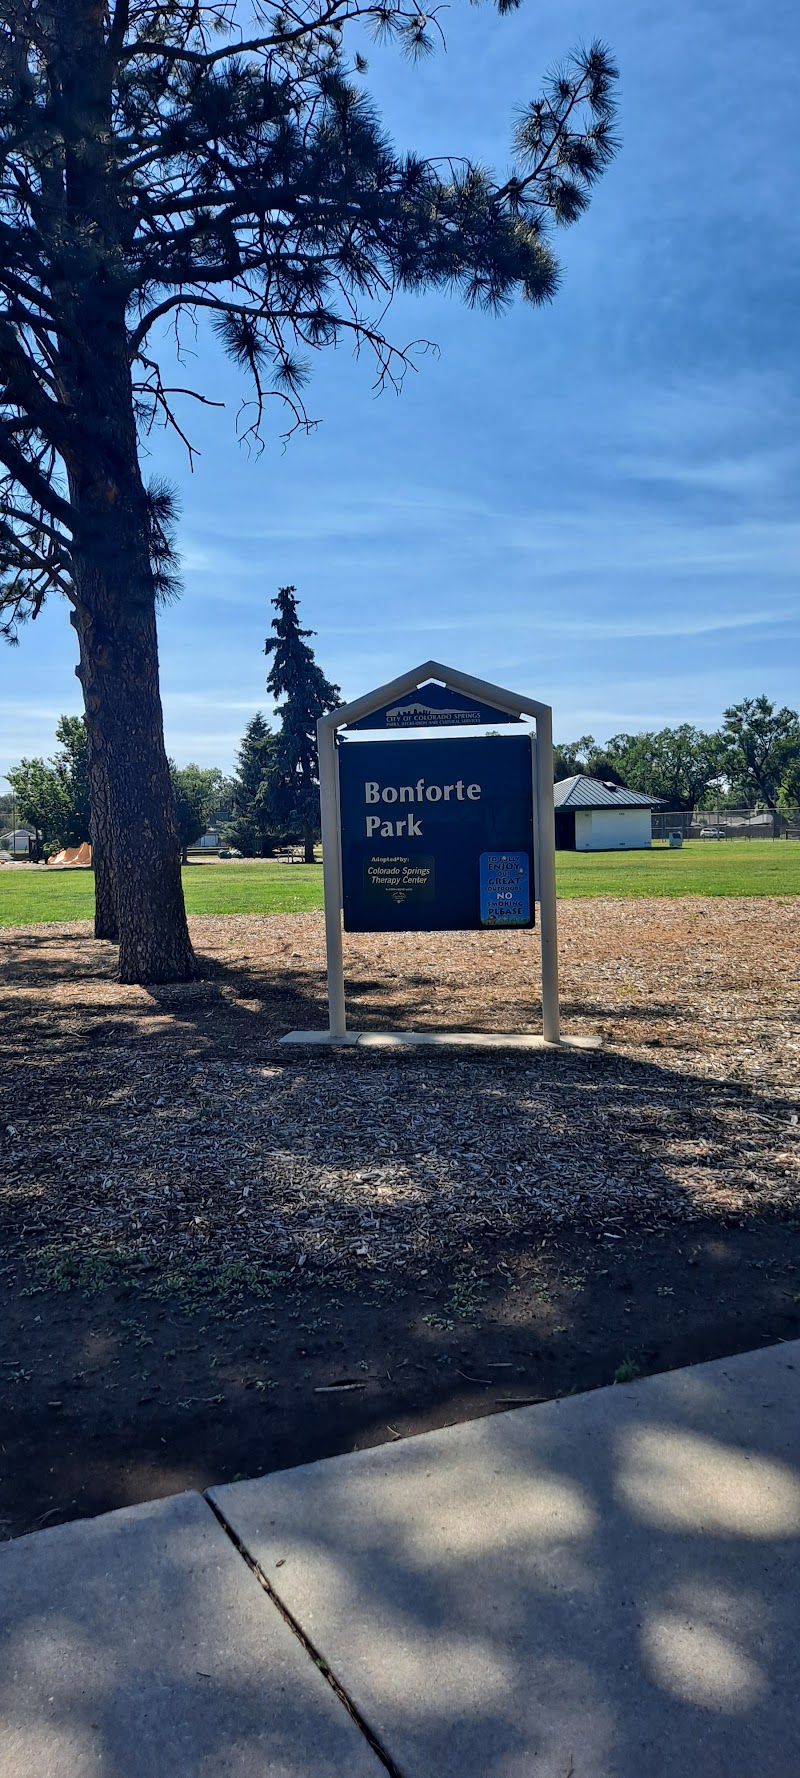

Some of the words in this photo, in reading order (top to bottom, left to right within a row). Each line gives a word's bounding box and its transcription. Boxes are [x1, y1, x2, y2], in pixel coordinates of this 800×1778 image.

[365, 778, 481, 804] Bonforte
[365, 813, 423, 837] Park
[367, 866, 400, 875] Colorado
[401, 866, 431, 876] Springs
[371, 876, 401, 885] Therapy
[402, 876, 428, 884] Center
[488, 877, 520, 885] GREAT
[496, 892, 513, 900] NO
